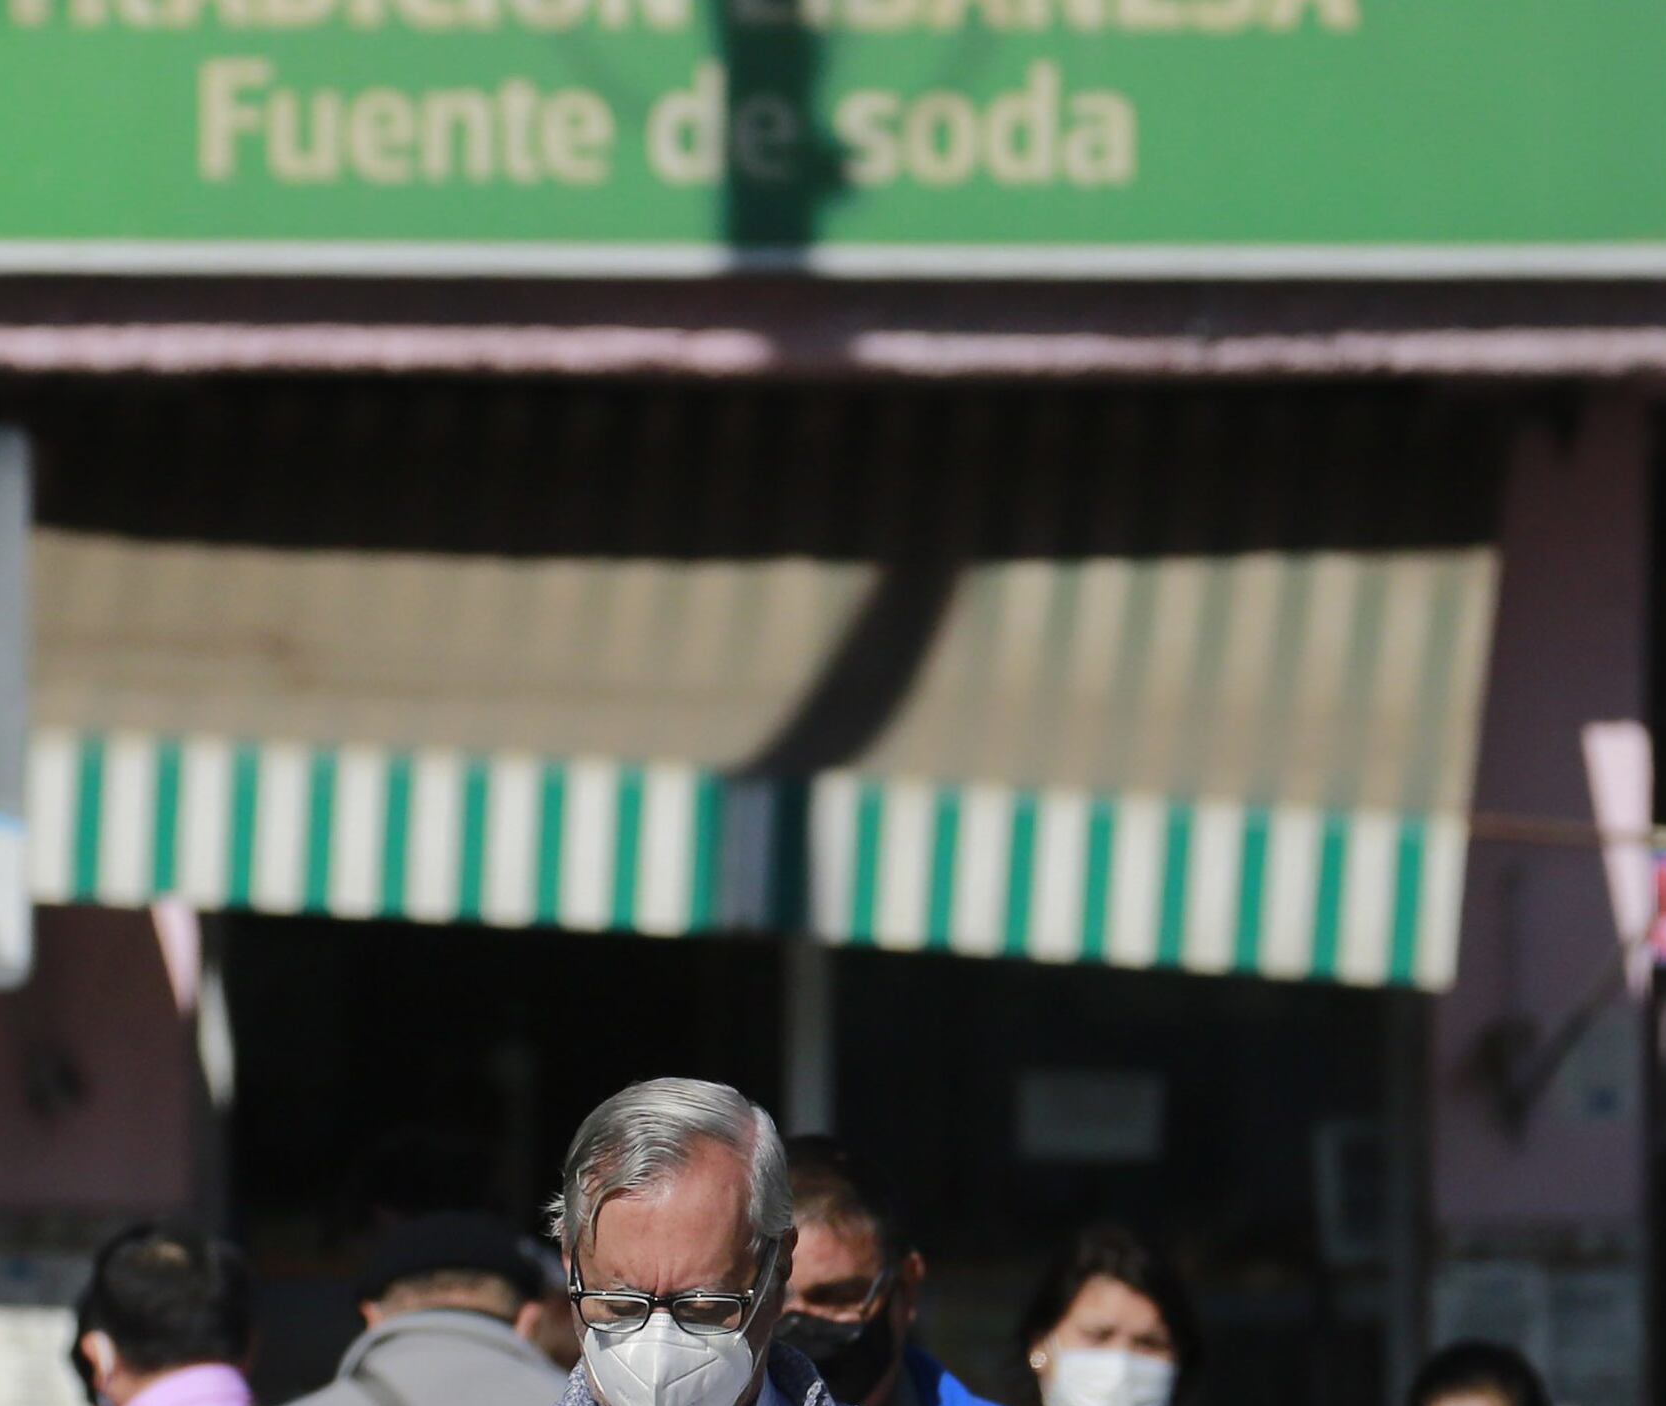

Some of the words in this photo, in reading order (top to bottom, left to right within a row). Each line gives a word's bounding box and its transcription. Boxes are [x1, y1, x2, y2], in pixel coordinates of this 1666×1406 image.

[196, 55, 614, 185] Fuente
[646, 58, 799, 186] de
[833, 58, 1137, 187] soda
